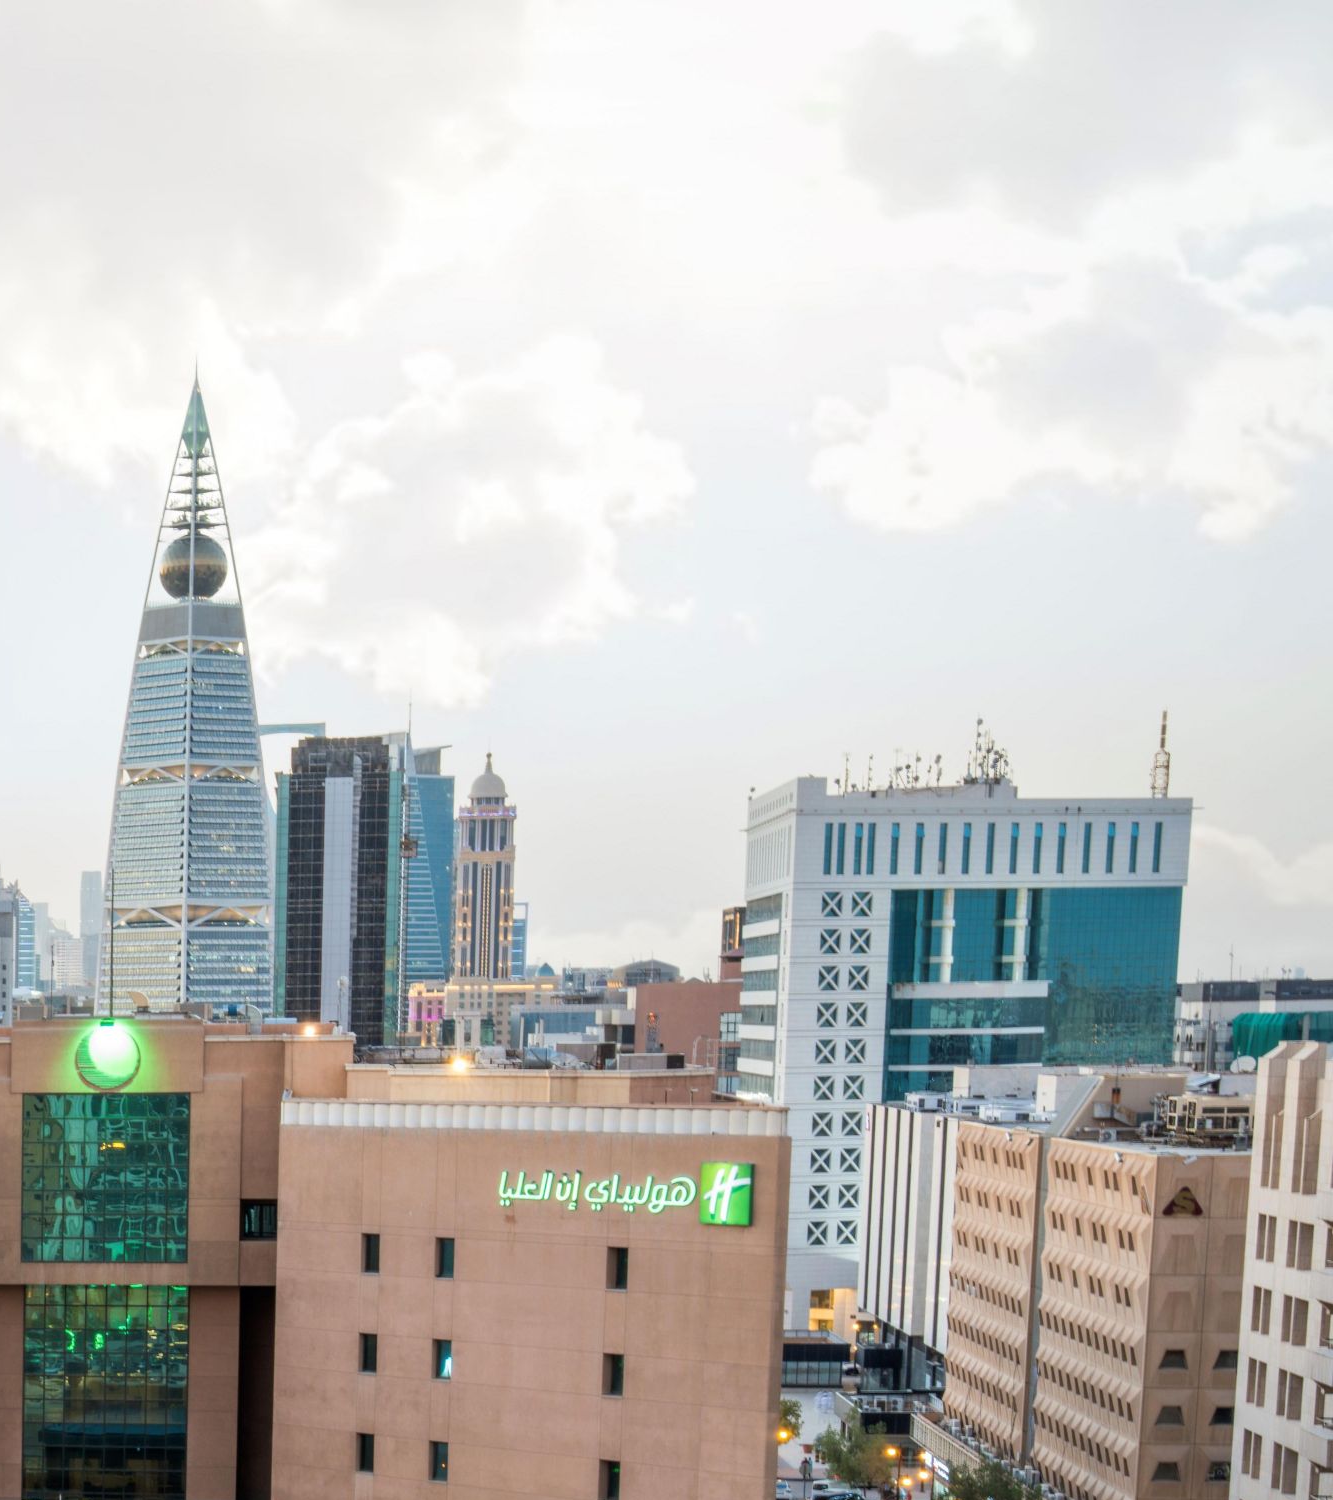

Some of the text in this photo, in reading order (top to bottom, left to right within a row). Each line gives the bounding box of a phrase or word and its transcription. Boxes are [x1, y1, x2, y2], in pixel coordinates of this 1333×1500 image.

[498, 1170, 696, 1214] هوليداي إن العليا
